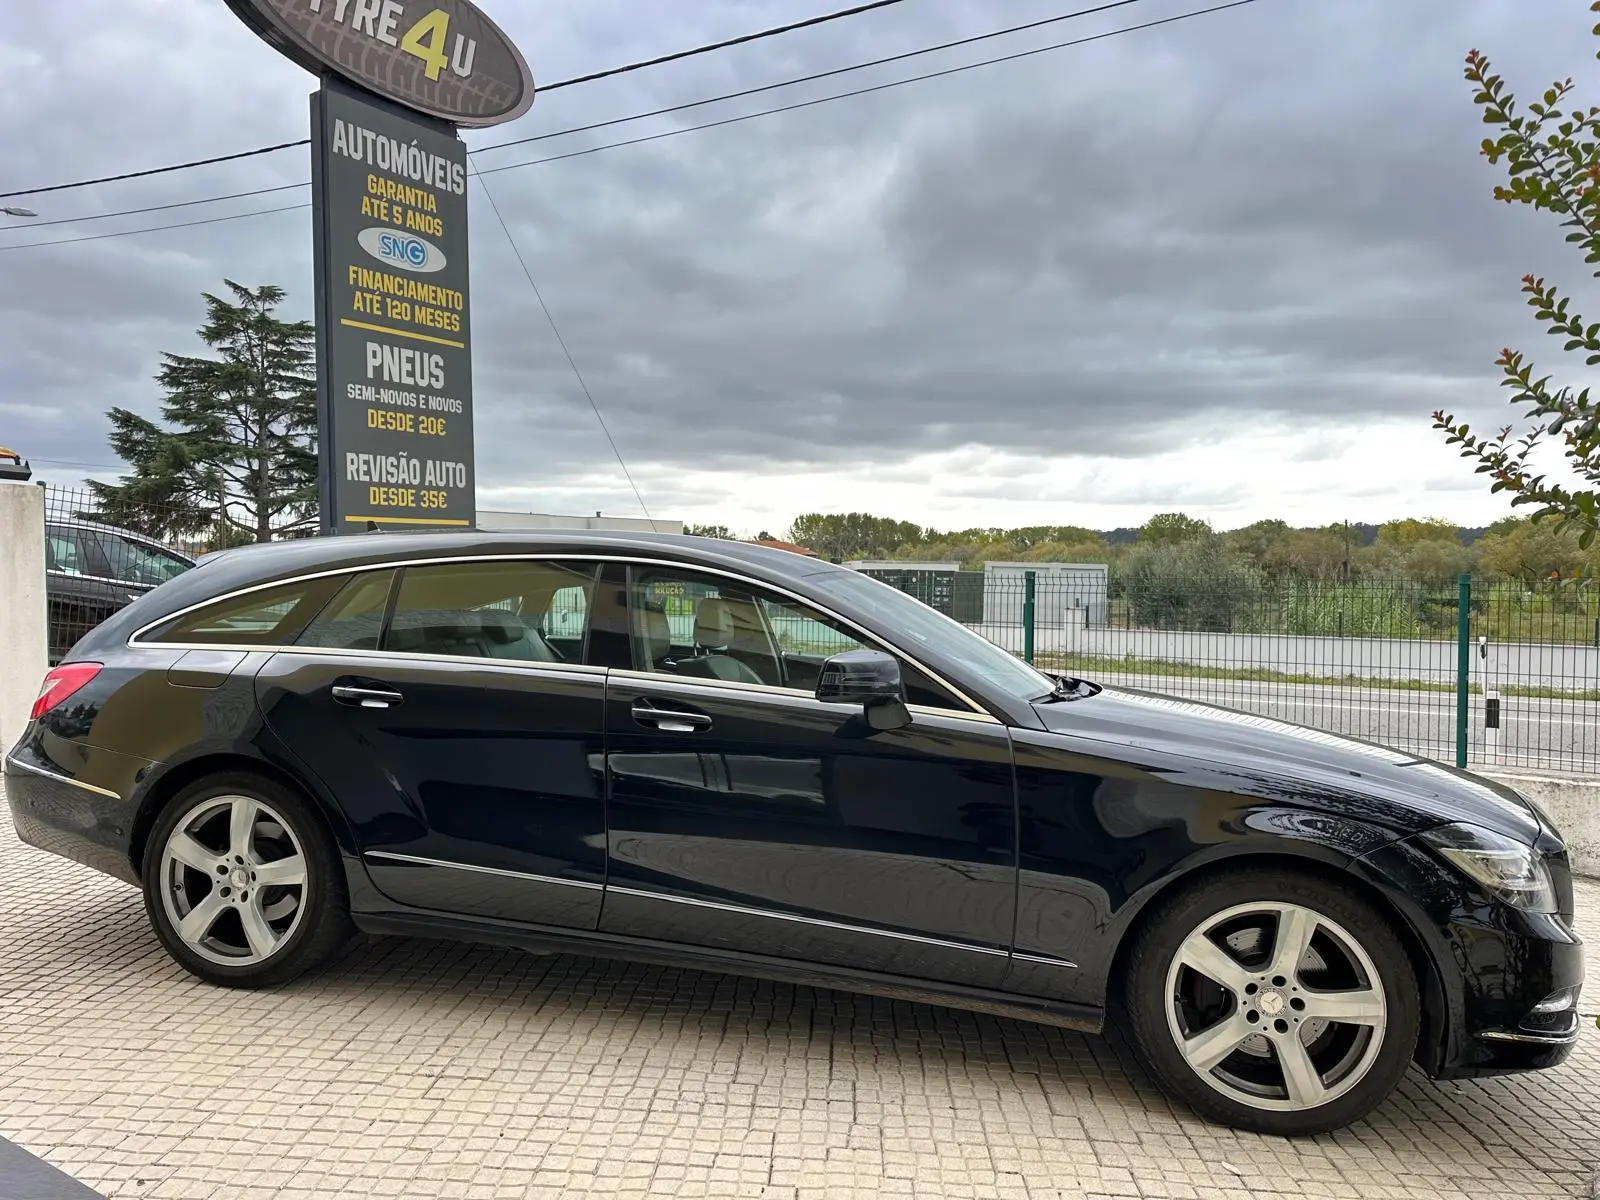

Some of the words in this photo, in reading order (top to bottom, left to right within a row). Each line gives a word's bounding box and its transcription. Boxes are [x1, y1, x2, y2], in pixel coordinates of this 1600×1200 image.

[332, 118, 465, 195] AUTOMÓVEIS
[367, 173, 437, 213] GARANTIA
[361, 196, 389, 223] ATÉ
[392, 206, 403, 225] 5
[406, 210, 443, 237] ANOS
[378, 233, 427, 268] SNG
[348, 265, 463, 311] FINANCIAMENTO
[353, 291, 382, 316] ATÉ
[386, 297, 411, 321] 120
[415, 305, 460, 332] MESES
[366, 341, 445, 390] PNEUS
[347, 383, 417, 407] SEMI-NOVOS
[419, 394, 426, 409] E
[428, 396, 462, 414] NOVOS
[367, 408, 415, 433] DESDE
[418, 415, 447, 436] 20€
[346, 451, 421, 486] REVISÃO
[425, 459, 466, 489] AUTO
[369, 486, 417, 507] DESDE
[420, 490, 448, 509] 35€
